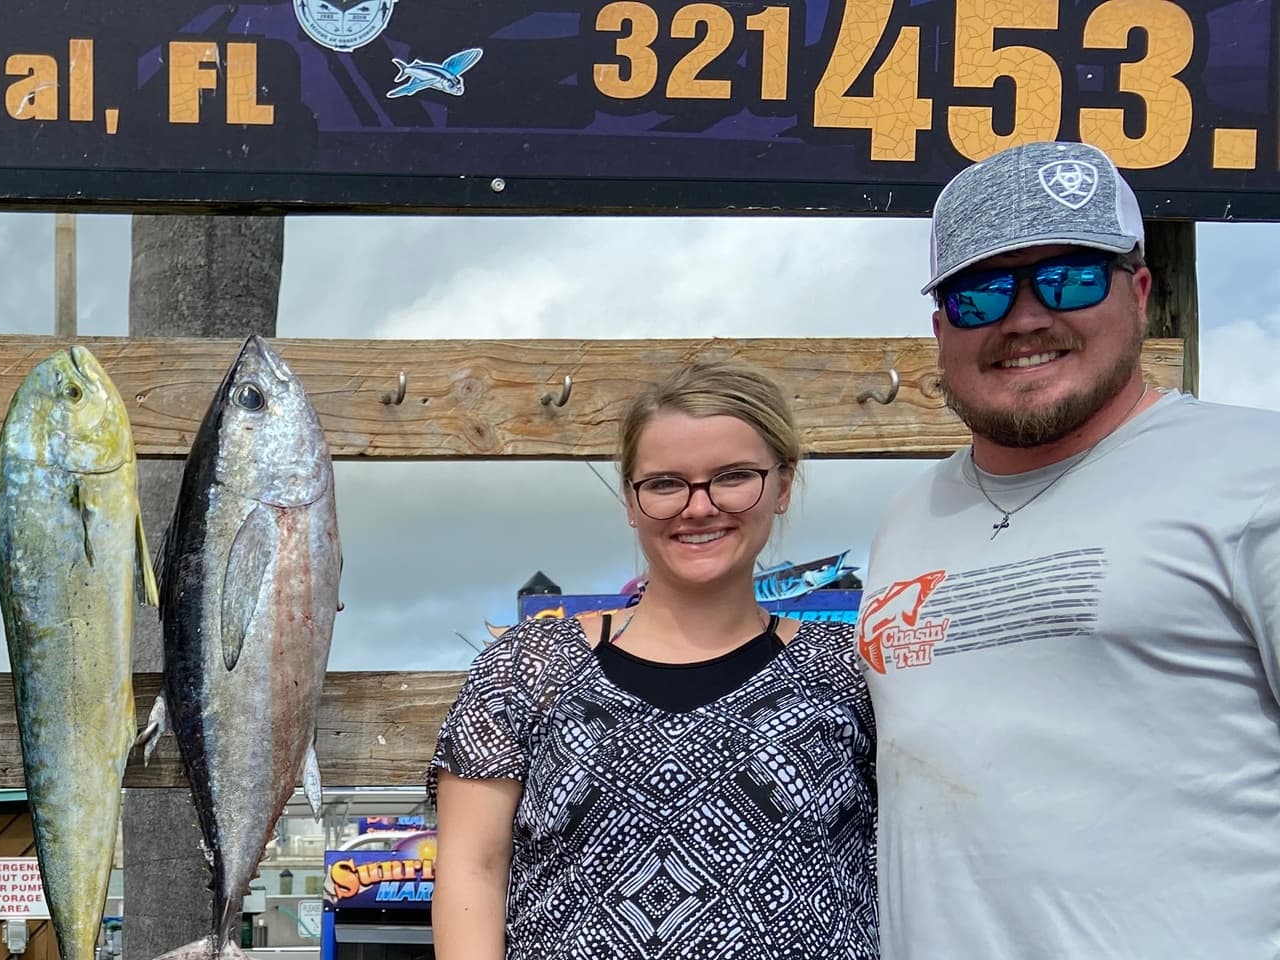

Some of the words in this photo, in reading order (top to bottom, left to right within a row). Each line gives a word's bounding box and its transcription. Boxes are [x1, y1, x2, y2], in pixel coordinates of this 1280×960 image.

[592, 1, 789, 101] 321
[167, 40, 275, 125] FL
[881, 618, 950, 648] Chasin'
[893, 643, 935, 669] Tail
[330, 858, 434, 899] Sunri
[376, 881, 434, 901] MAR
[0, 904, 30, 913] AREA
